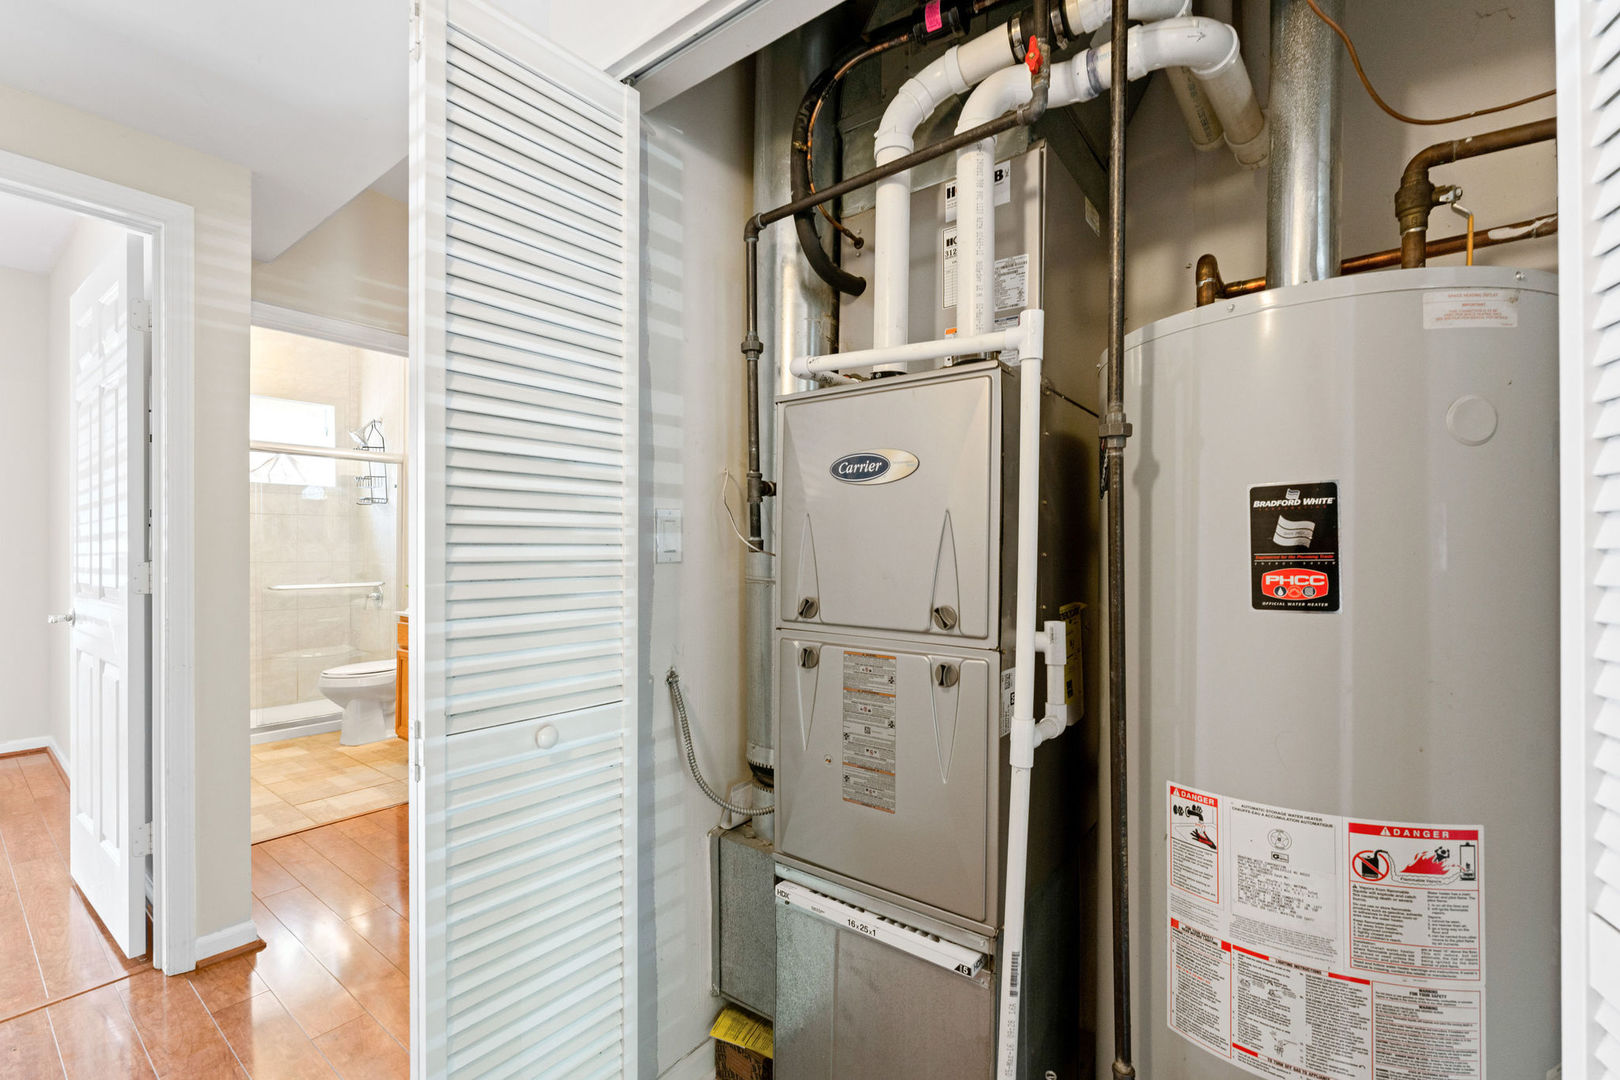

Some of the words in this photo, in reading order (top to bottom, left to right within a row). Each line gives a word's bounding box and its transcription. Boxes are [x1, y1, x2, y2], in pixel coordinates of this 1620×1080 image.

[838, 460, 882, 474] Carrier
[1253, 499, 1301, 508] BRADFORD
[1266, 575, 1325, 585] PHCC
[1181, 790, 1214, 806] DANGER
[1393, 828, 1450, 838] DANGER
[777, 888, 790, 899] HDX
